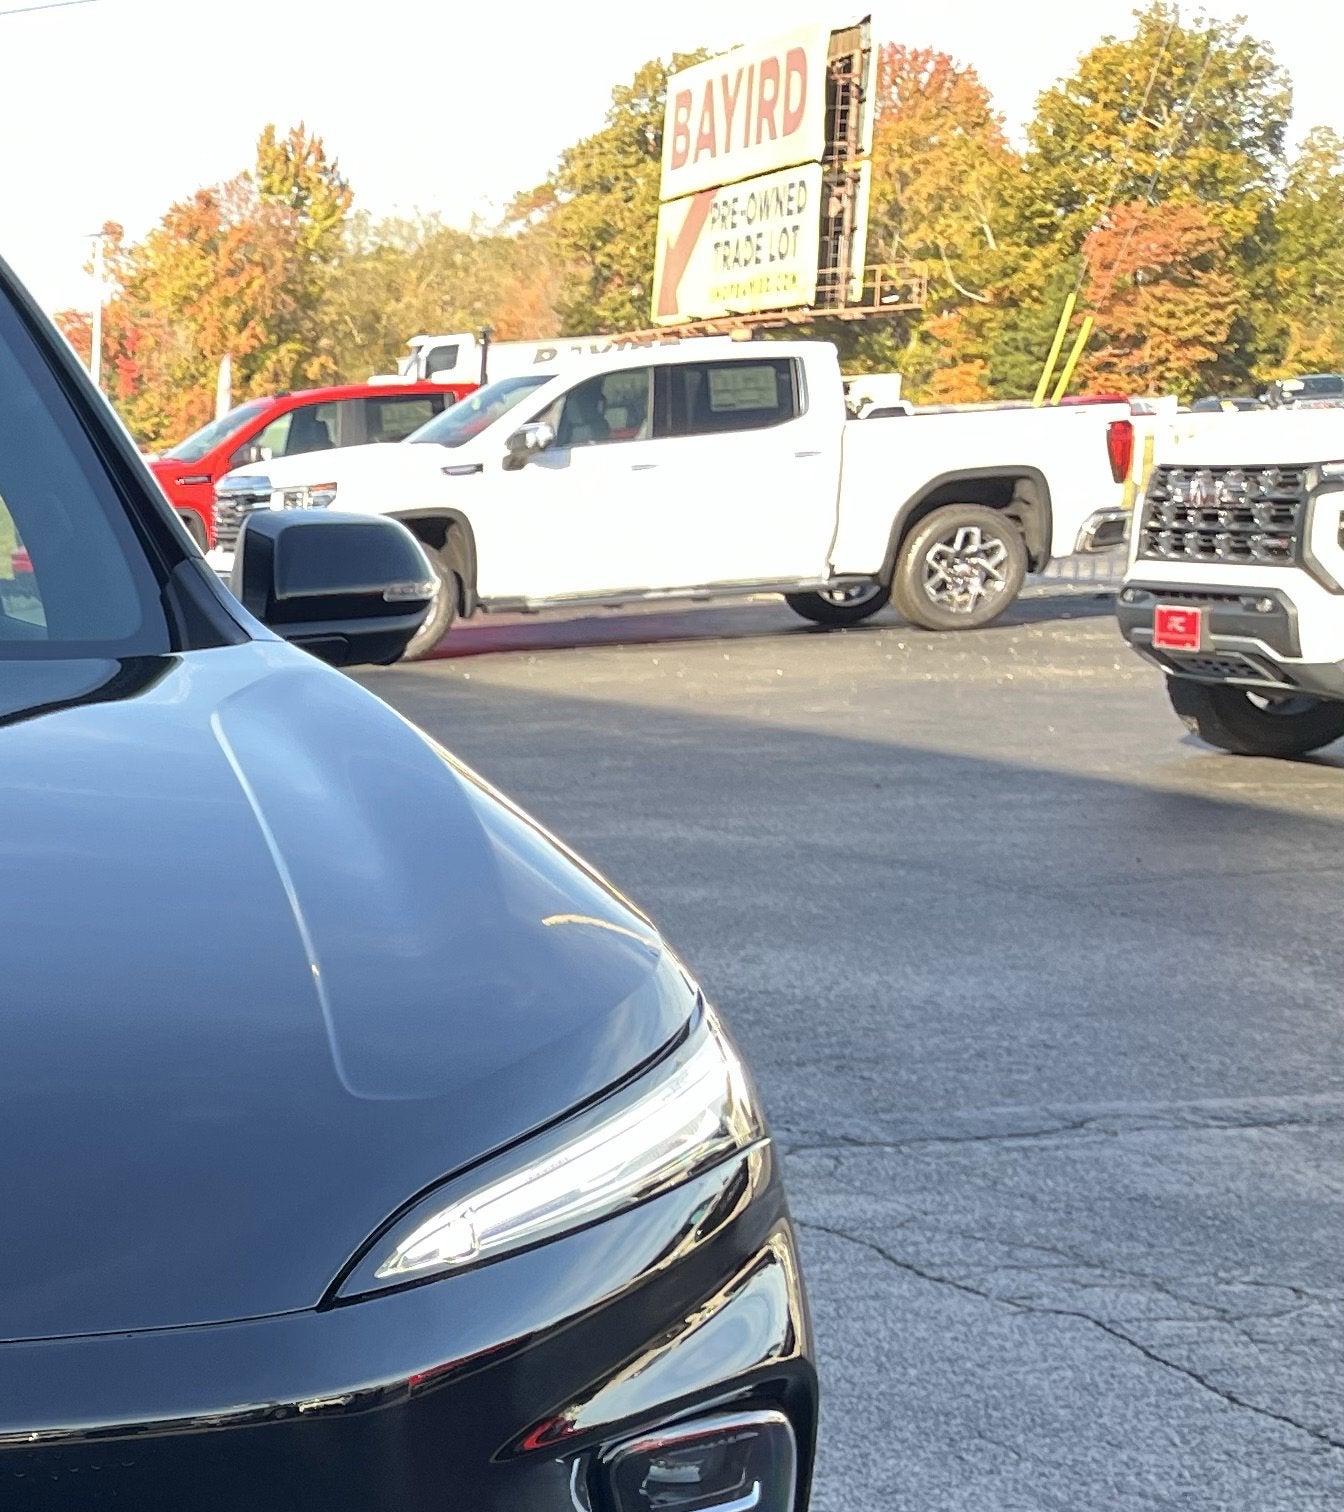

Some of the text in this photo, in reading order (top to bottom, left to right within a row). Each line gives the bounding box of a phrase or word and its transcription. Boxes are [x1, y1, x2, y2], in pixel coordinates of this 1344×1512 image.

[671, 47, 807, 171] BAYIRD
[711, 180, 807, 230] PRE-OWNED
[713, 225, 800, 271] TRADE LOT
